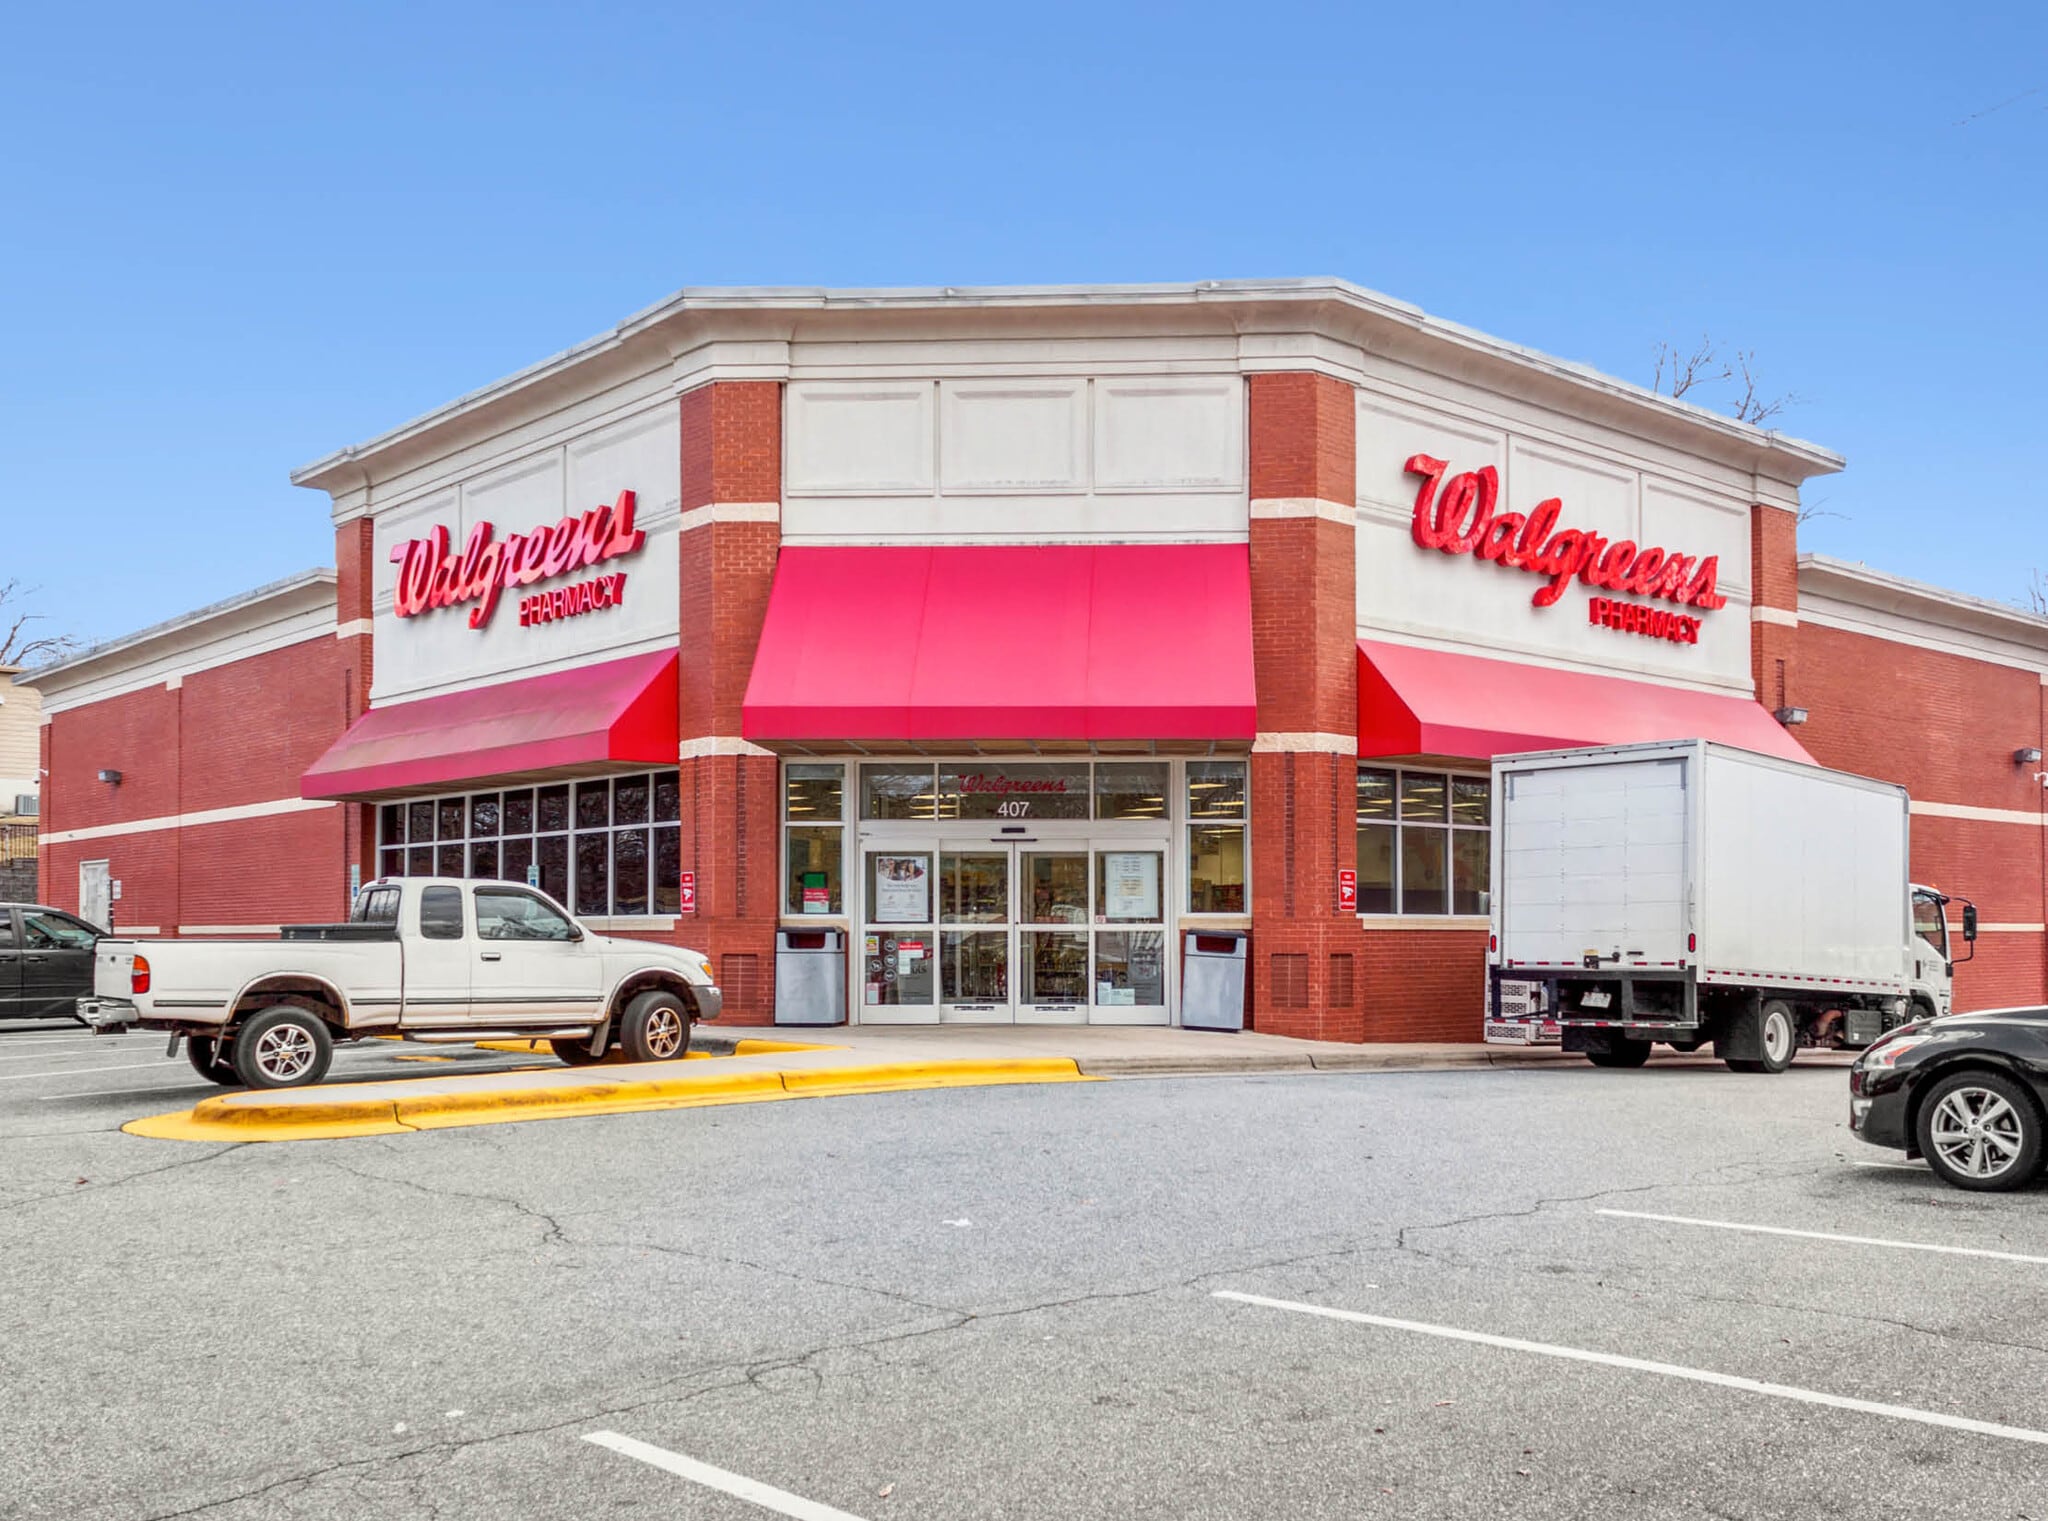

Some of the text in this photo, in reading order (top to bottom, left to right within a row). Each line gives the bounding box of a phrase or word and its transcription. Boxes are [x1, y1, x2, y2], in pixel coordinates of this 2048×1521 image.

[1404, 453, 1727, 609] Walgreens
[390, 489, 646, 629] Walgreens
[519, 572, 627, 626] PHARMACY
[1589, 597, 1702, 644] PHARMACY
[958, 772, 1067, 799] Walgreens
[997, 801, 1030, 817] 407
